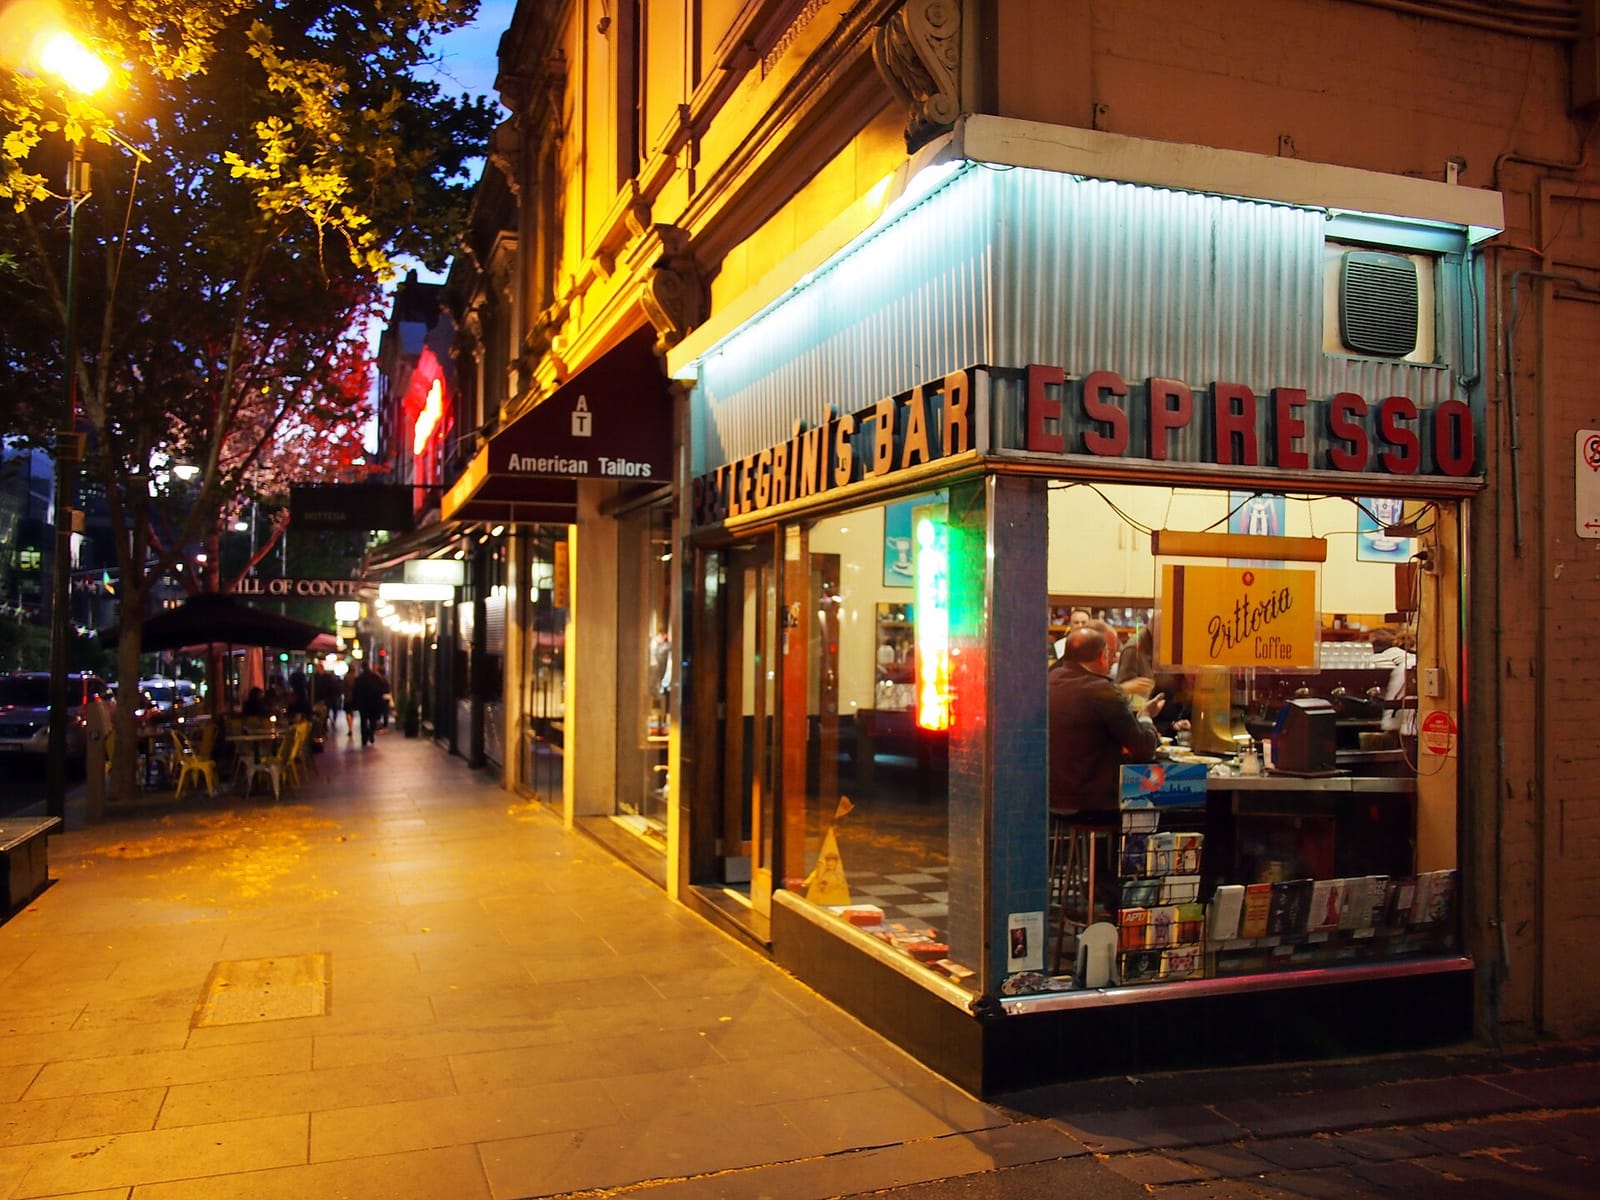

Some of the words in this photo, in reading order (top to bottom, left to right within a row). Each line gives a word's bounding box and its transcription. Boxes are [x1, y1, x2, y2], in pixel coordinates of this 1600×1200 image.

[874, 369, 969, 477] BAR
[1024, 364, 1476, 477] ESPRESSO
[508, 453, 588, 474] American
[598, 457, 652, 477] Tailors
[231, 579, 265, 594] ILL
[269, 579, 293, 595] OF
[1208, 587, 1293, 659] Vittoria
[1254, 635, 1292, 660] Coffee
